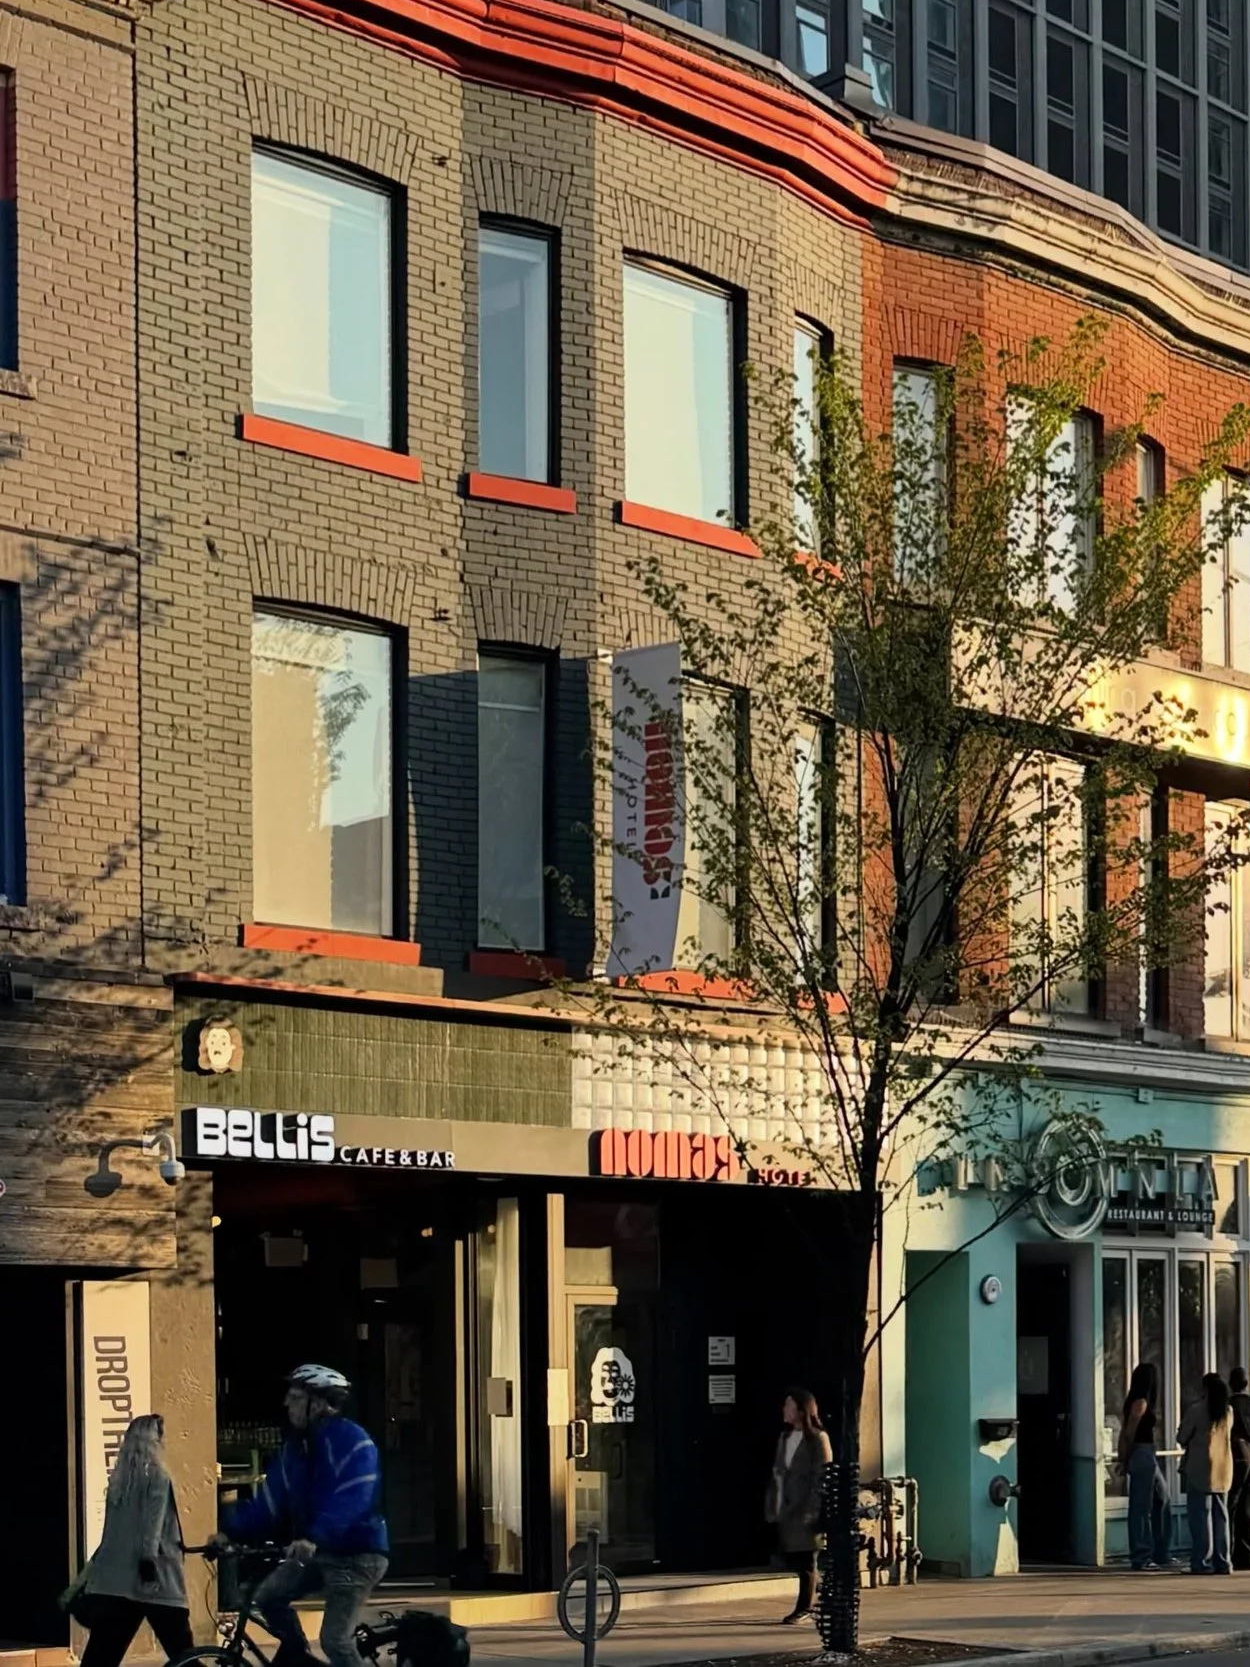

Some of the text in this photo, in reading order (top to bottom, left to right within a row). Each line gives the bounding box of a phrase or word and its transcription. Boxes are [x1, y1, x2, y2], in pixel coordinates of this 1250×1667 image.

[758, 1168, 814, 1187] HOTE
[1107, 1208, 1213, 1223] RESTAURANT & LOUNGE
